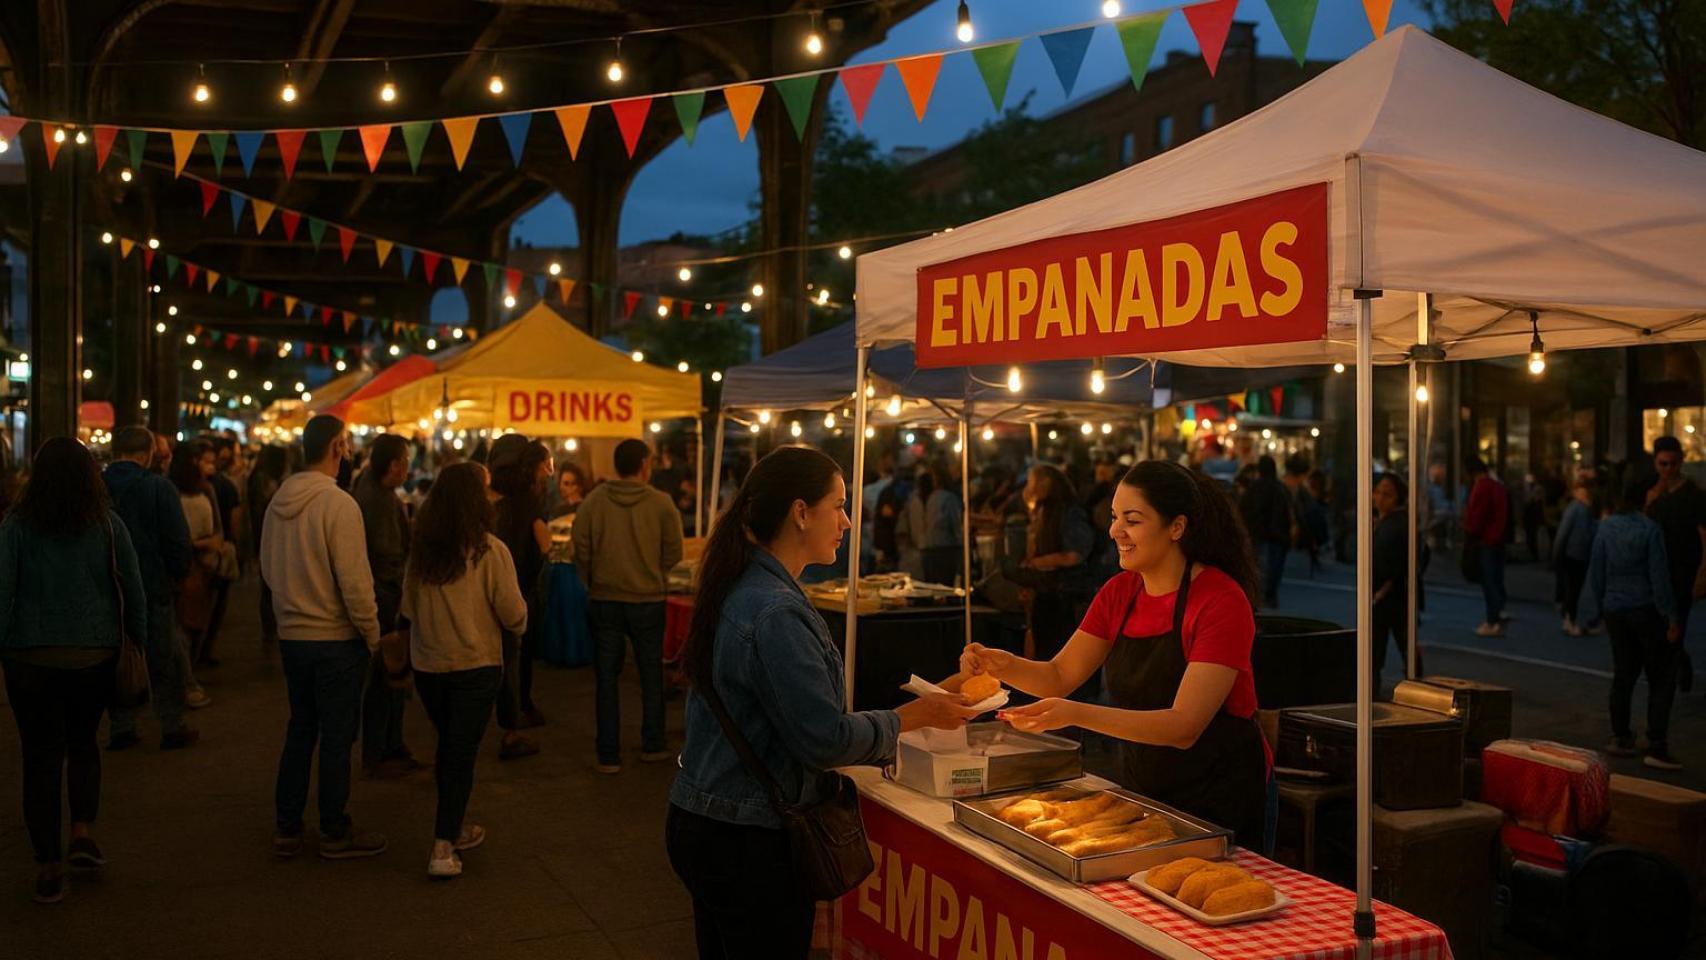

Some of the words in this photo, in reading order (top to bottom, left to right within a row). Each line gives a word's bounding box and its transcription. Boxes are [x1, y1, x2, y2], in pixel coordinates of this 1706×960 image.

[930, 221, 1303, 347] EMPANADAS
[510, 391, 632, 422] DRINKS
[858, 840, 1066, 960] EMPAN
